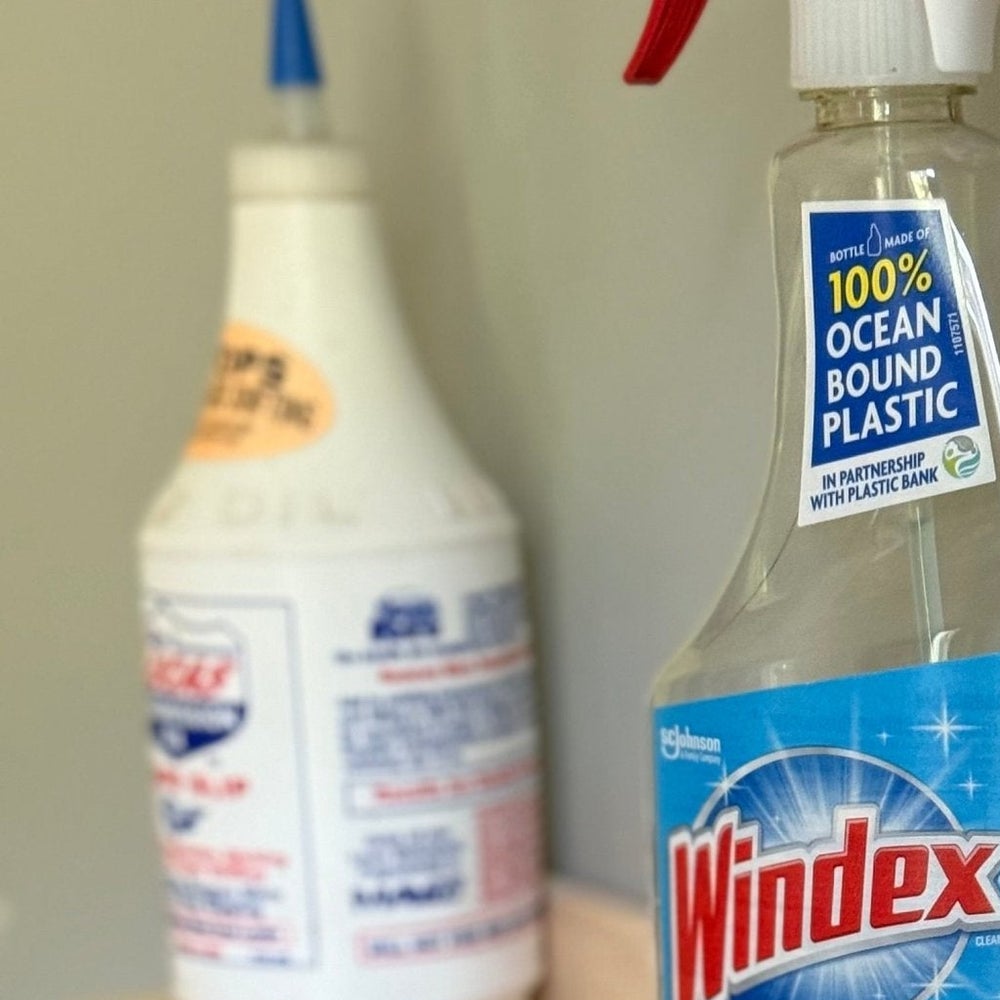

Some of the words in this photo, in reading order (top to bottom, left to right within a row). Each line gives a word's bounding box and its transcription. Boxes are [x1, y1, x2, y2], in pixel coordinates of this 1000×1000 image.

[829, 244, 865, 263] BOTTLE
[885, 231, 914, 249] MADE
[916, 227, 930, 239] OF
[829, 248, 932, 314] 100%
[826, 297, 940, 358] OCEAN
[827, 345, 941, 404] BOUND
[823, 381, 958, 448] PLASTIC
[810, 489, 844, 511] WITH
[848, 477, 899, 502] PLASTIC
[902, 467, 938, 489] BANK
[822, 473, 836, 490] IN
[840, 452, 925, 486] PARTNERSHIP
